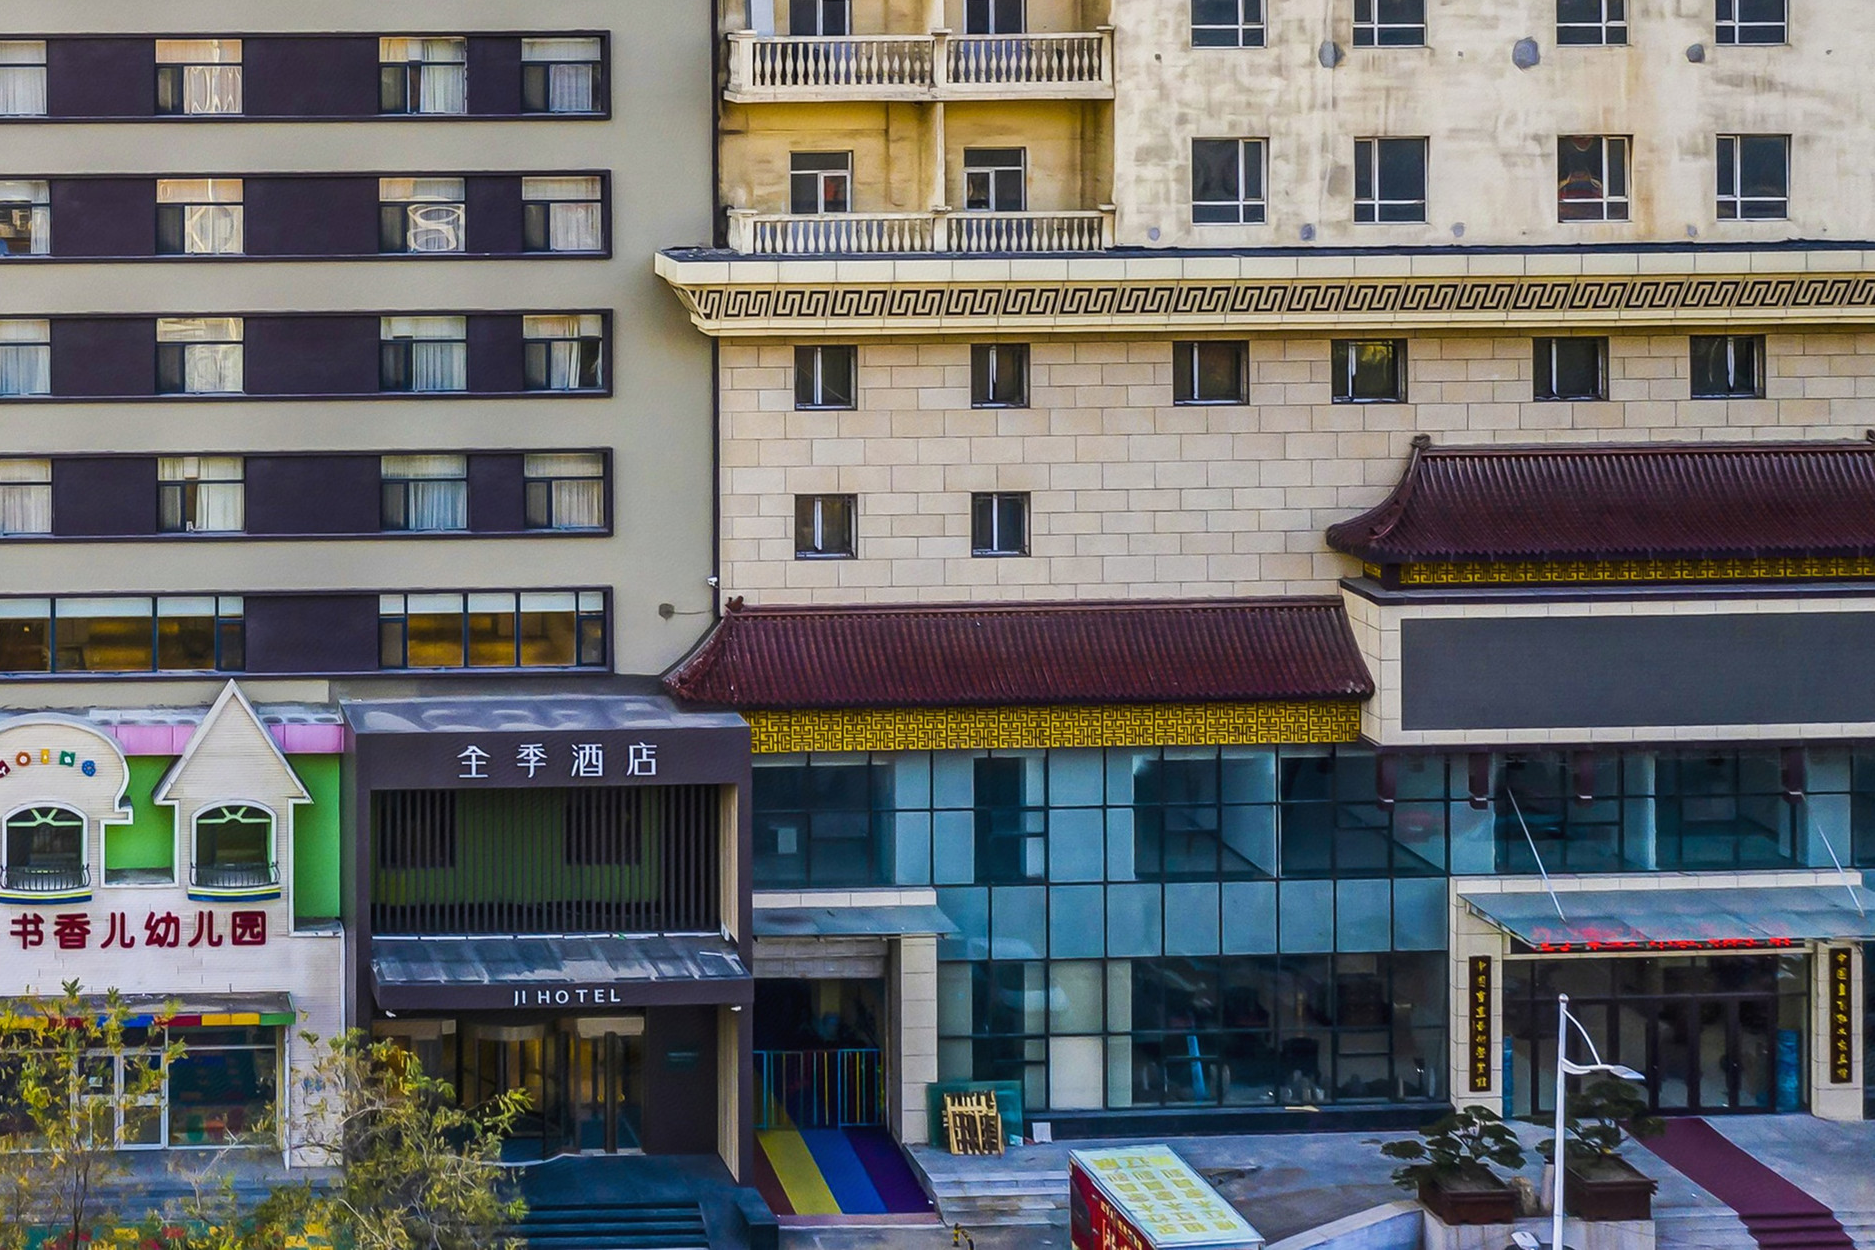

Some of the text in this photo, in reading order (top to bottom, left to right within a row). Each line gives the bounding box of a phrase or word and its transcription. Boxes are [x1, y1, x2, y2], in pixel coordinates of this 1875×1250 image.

[456, 742, 659, 778] 全季酒店
[513, 988, 622, 1007] JI HOTEL
